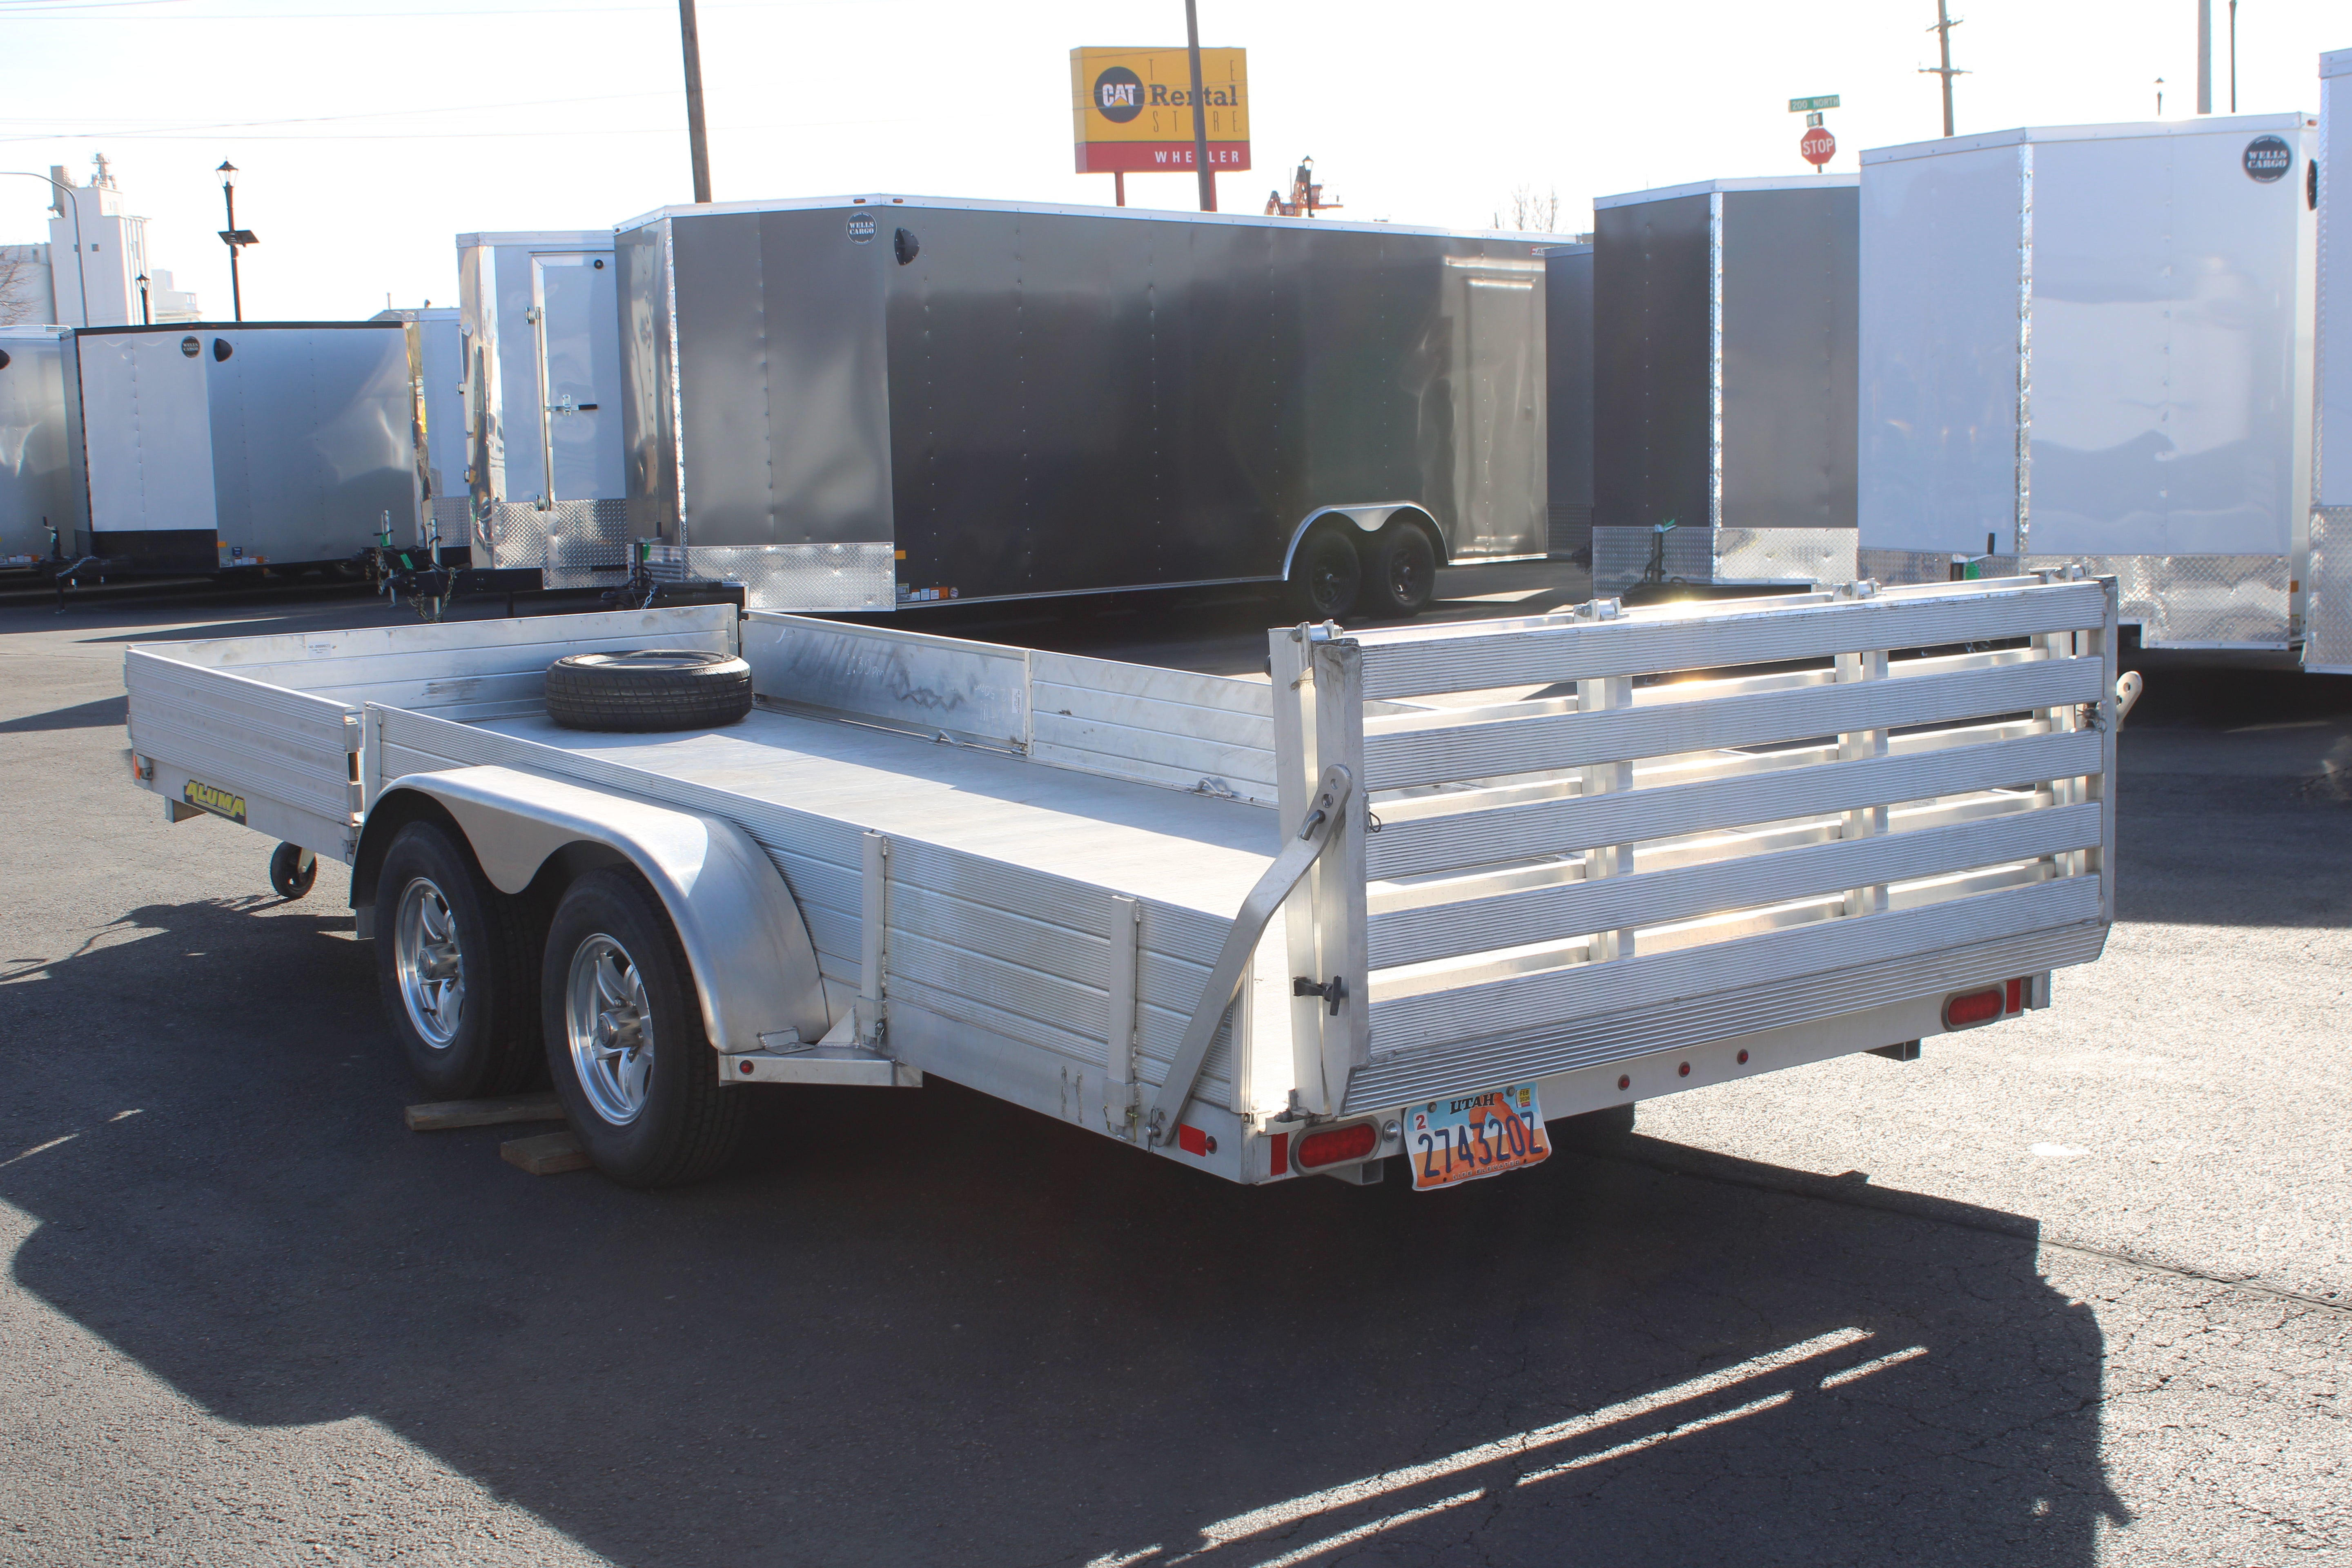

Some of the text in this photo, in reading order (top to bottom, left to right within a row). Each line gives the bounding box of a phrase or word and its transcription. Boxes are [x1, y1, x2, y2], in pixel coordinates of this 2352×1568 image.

[1149, 59, 1235, 81] TE
[1102, 84, 1136, 107] CAT
[1813, 97, 1839, 108] NORTH
[1153, 111, 1237, 132] STRE
[1803, 138, 1833, 155] STOP
[2247, 150, 2287, 159] WELLS
[1155, 151, 1239, 163] WHELER
[2247, 159, 2287, 169] CARGO
[185, 781, 245, 817] ALUMA
[1450, 1093, 1495, 1114] UTAH
[1415, 1115, 1426, 1130] 2
[1418, 1111, 1543, 1178] 274320Z
[1453, 1160, 1520, 1179] LIFE ELEVATED
